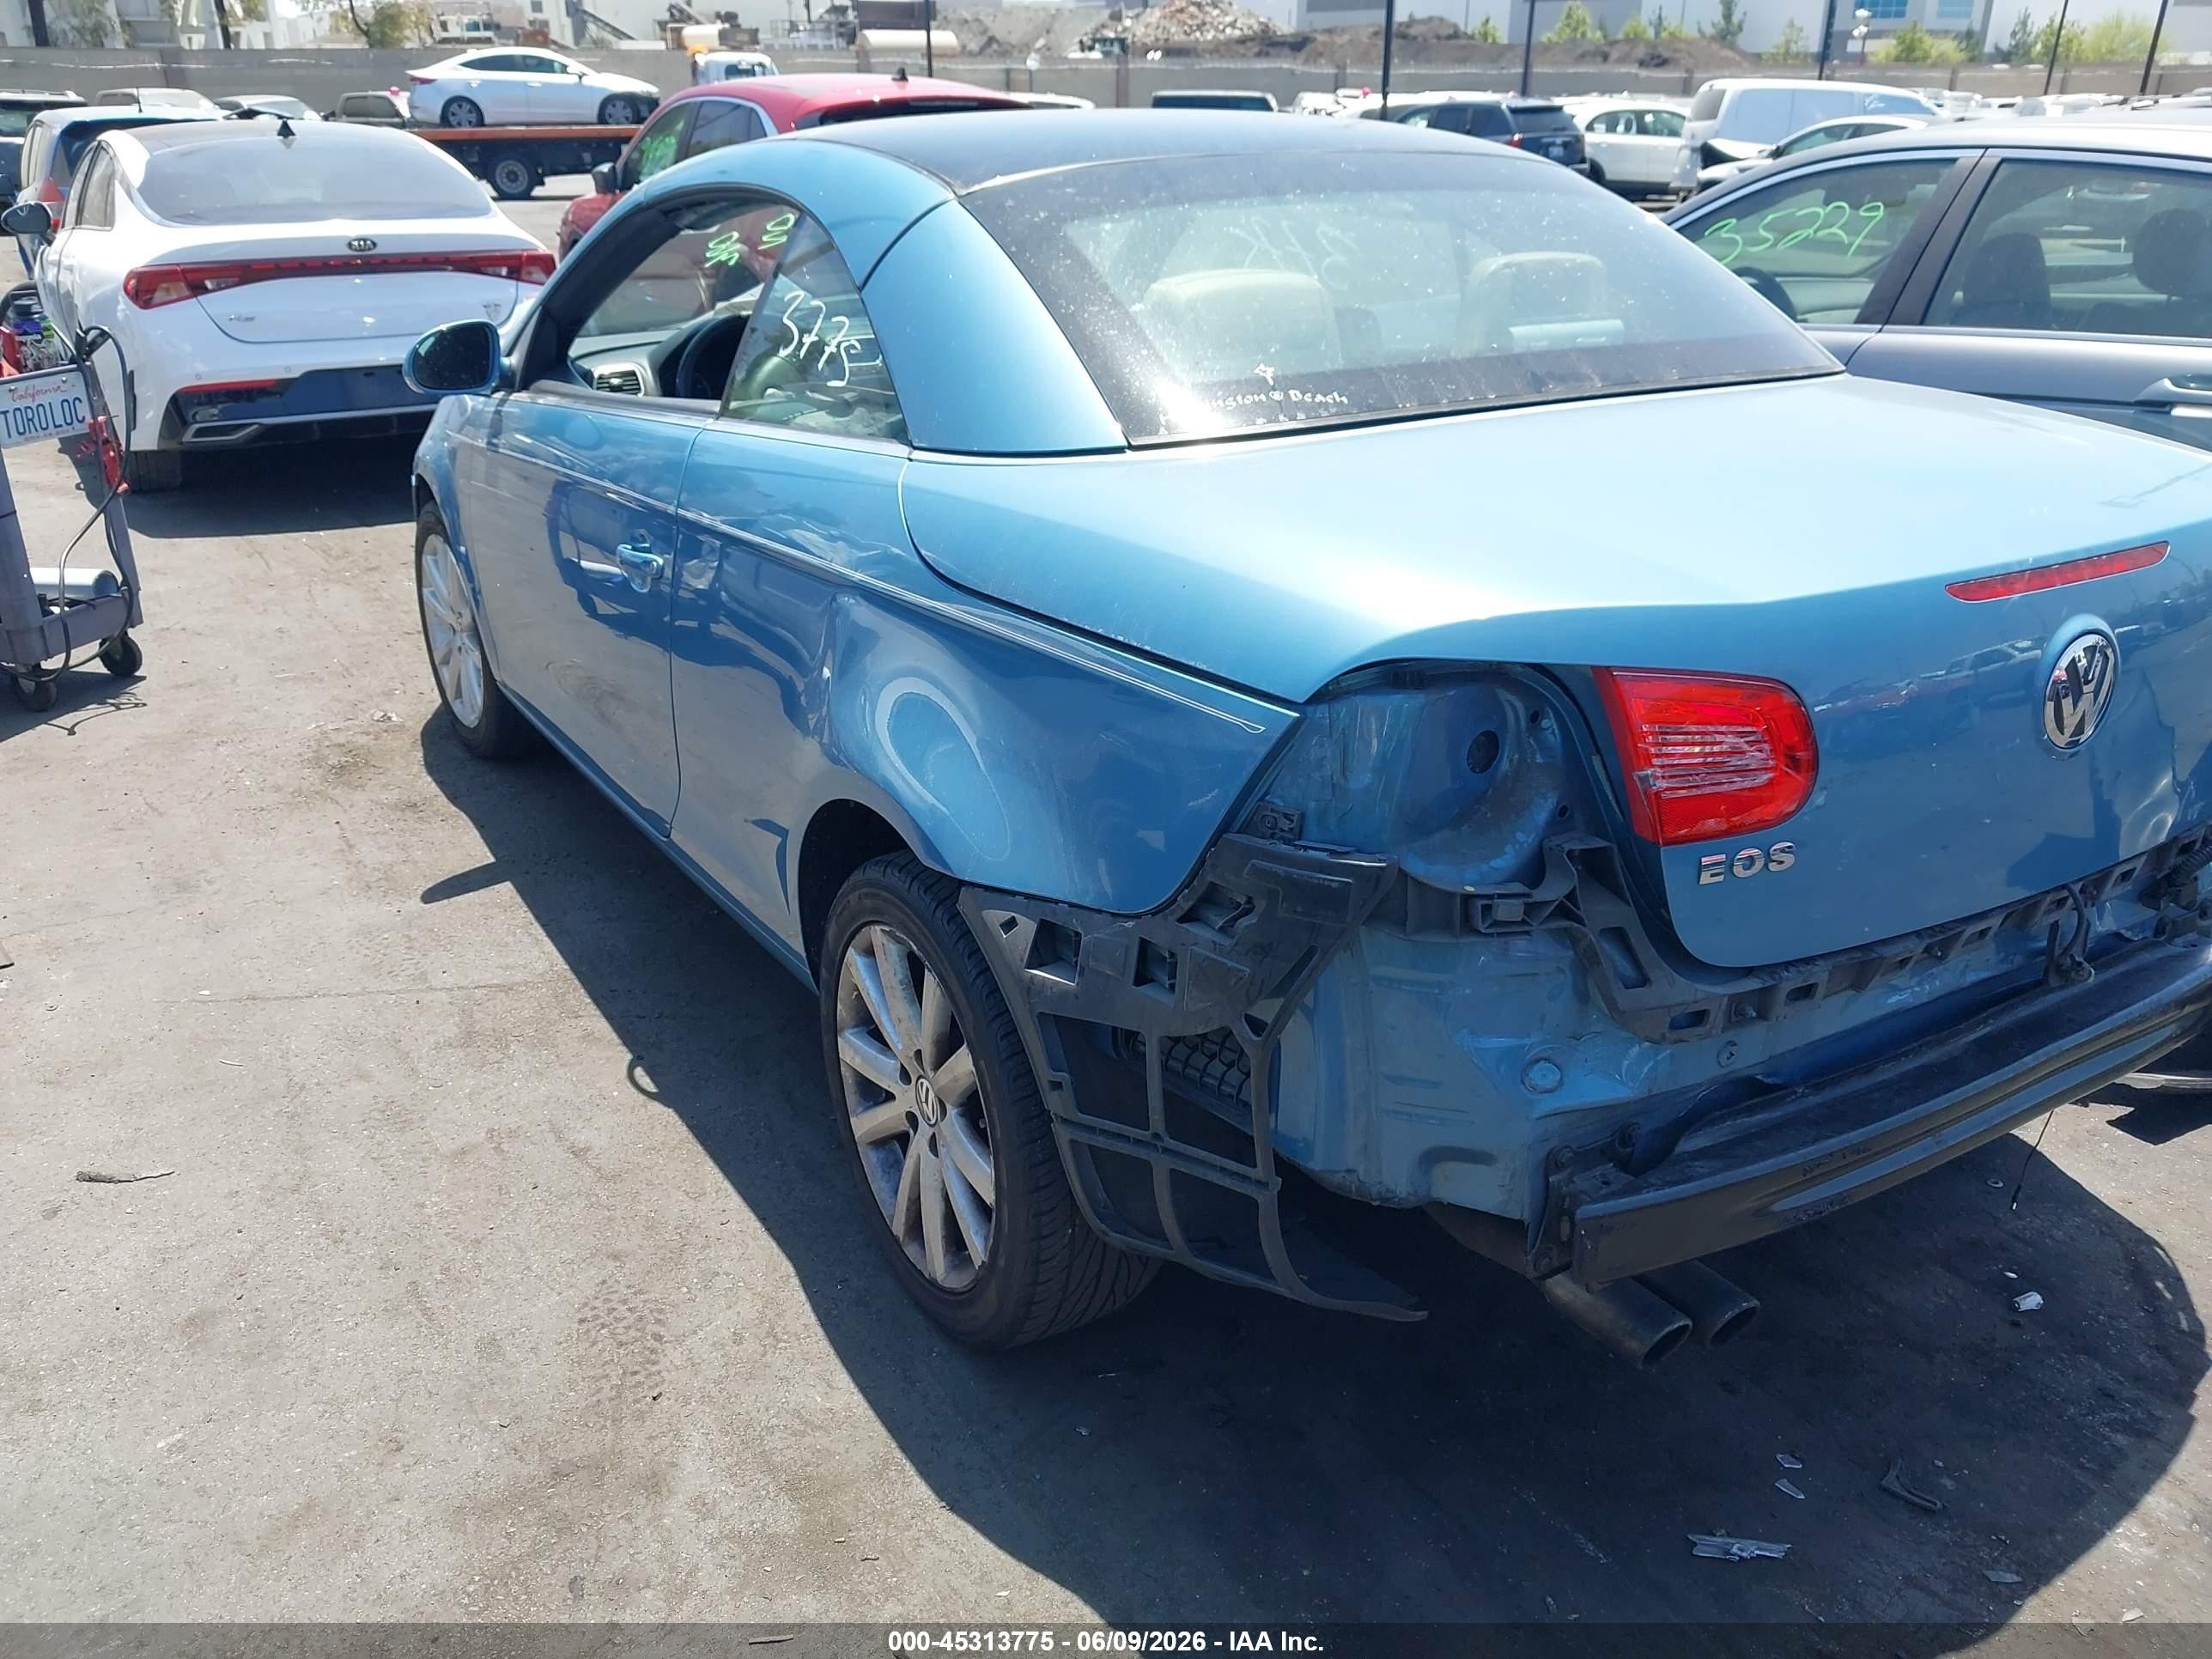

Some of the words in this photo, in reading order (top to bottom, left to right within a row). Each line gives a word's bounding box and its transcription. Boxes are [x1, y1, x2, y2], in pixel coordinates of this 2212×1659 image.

[1704, 201, 1883, 264] 35229
[777, 290, 862, 387] 3775
[0, 397, 86, 440] TOROLOC
[1699, 842, 1796, 885] EOS
